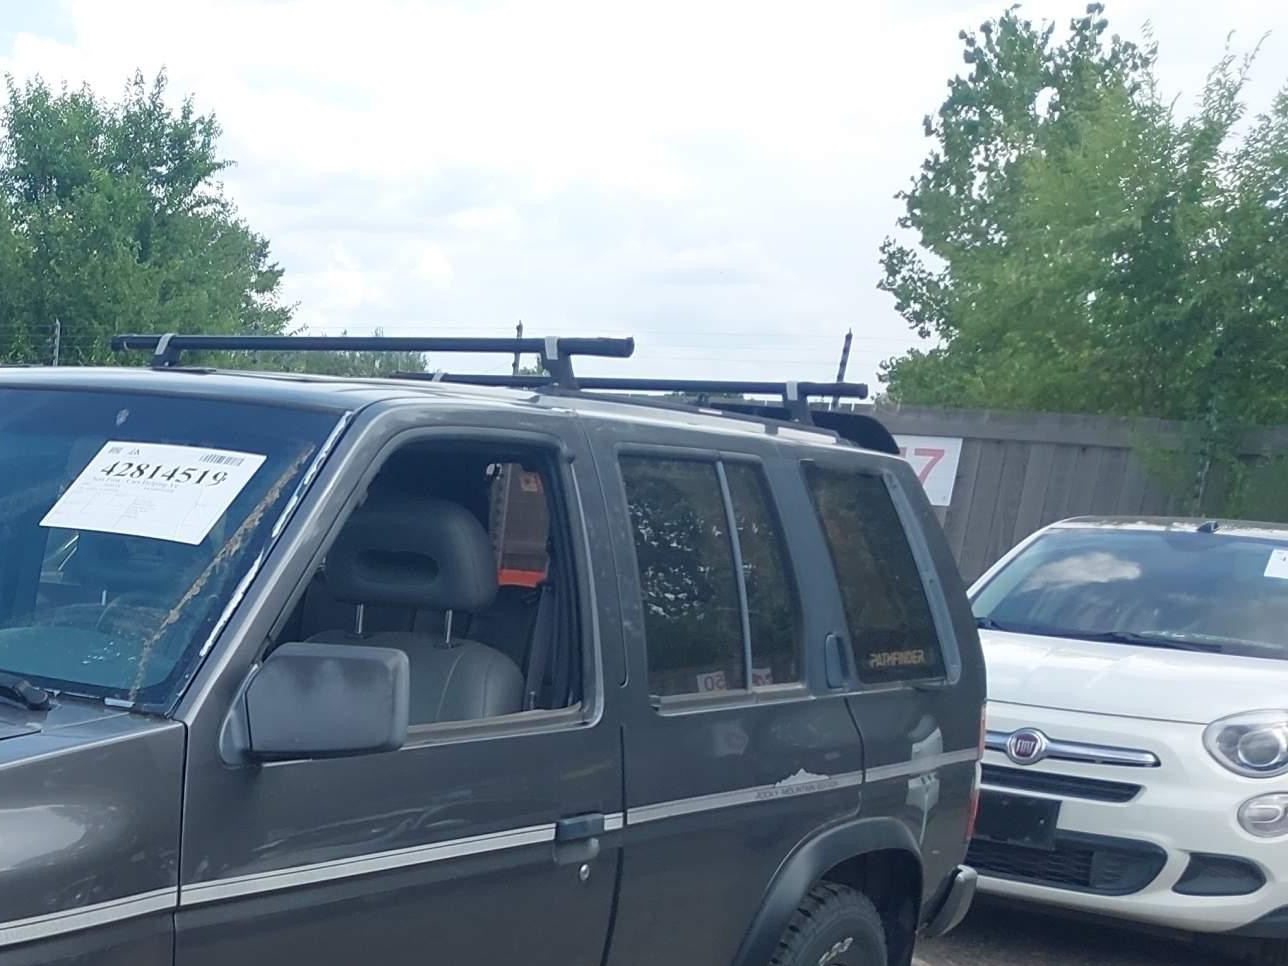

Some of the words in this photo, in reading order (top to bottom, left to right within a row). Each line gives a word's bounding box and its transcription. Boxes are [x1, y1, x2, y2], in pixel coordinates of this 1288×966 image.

[100, 460, 228, 487] 42814519
[899, 447, 945, 485] 7
[869, 649, 926, 669] PATHFINDER
